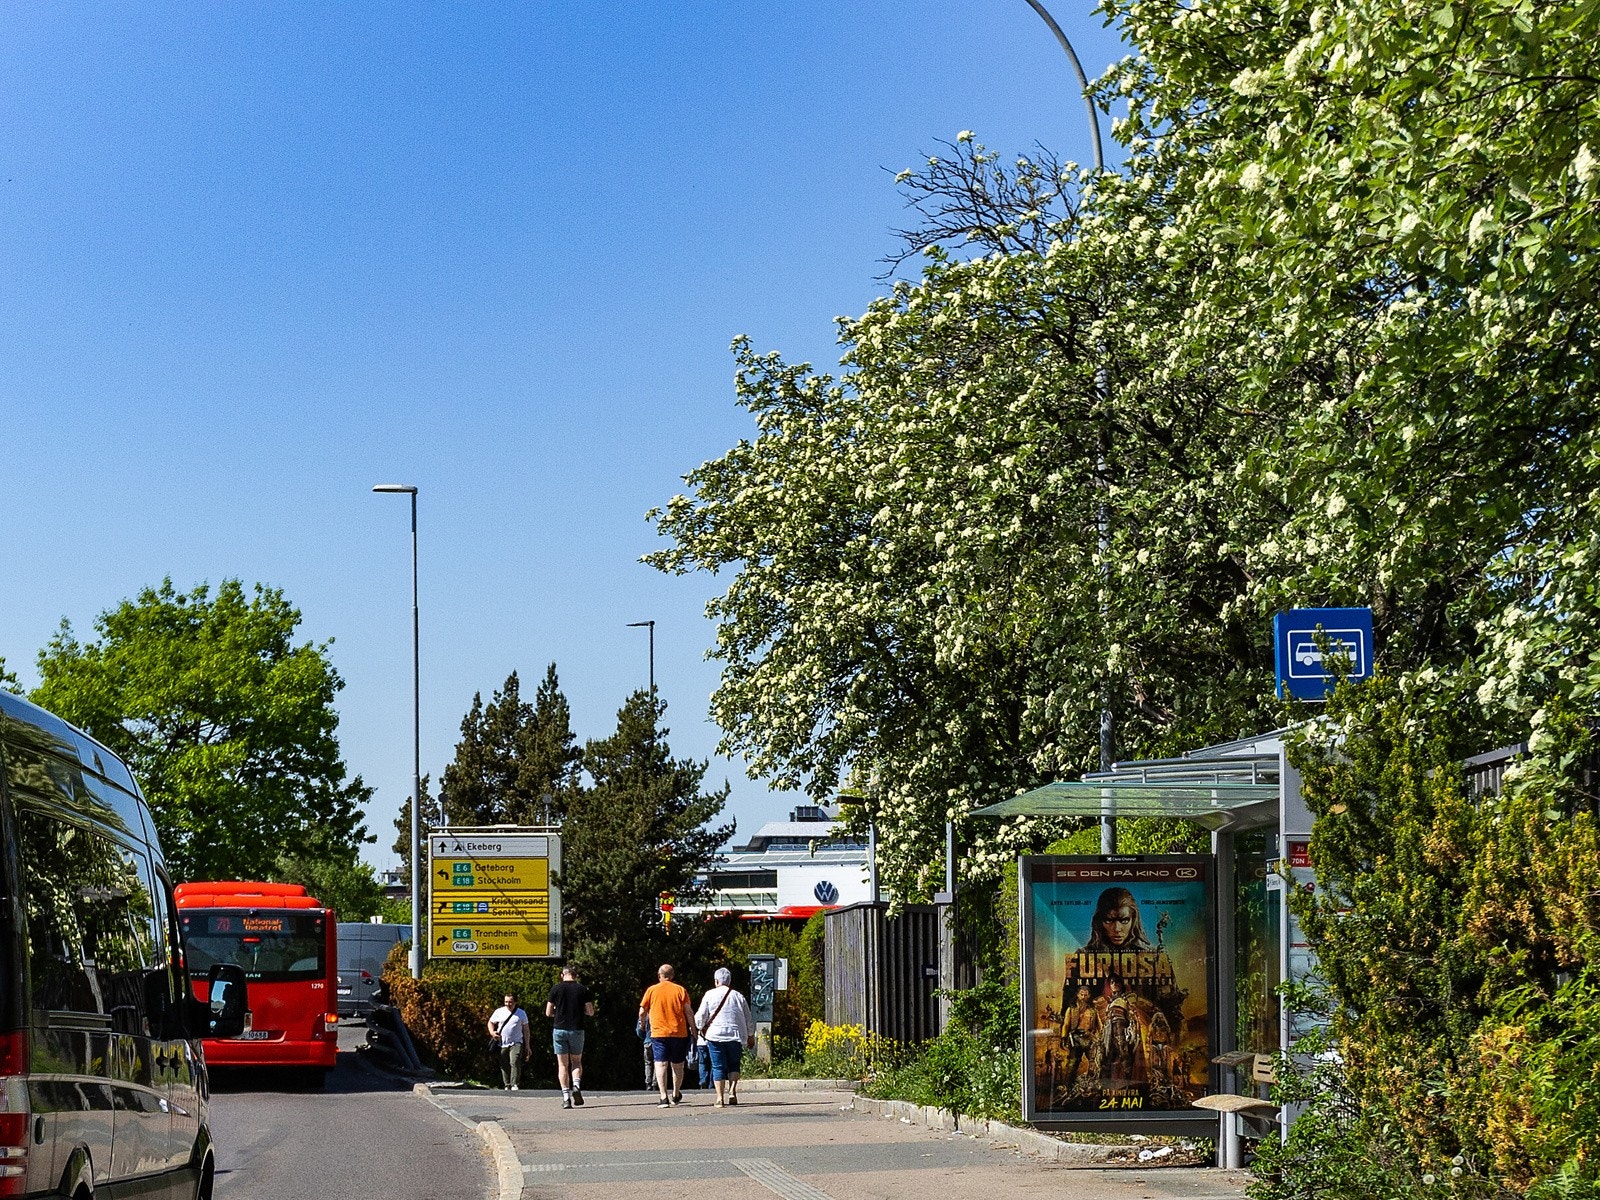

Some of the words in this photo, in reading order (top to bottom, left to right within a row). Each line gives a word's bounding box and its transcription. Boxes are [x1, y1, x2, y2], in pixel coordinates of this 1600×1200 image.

[467, 842, 502, 852] Ekeberg
[1113, 869, 1133, 877] PÅ
[477, 876, 522, 885] Stockholm
[491, 897, 544, 905] Kristiansand
[492, 907, 528, 916] Sentrum
[475, 929, 518, 938] Trondheim
[455, 943, 469, 951] Ring
[481, 942, 510, 950] Sinsen
[1064, 952, 1172, 978] FURIOSA
[1121, 1096, 1143, 1109] MAI
